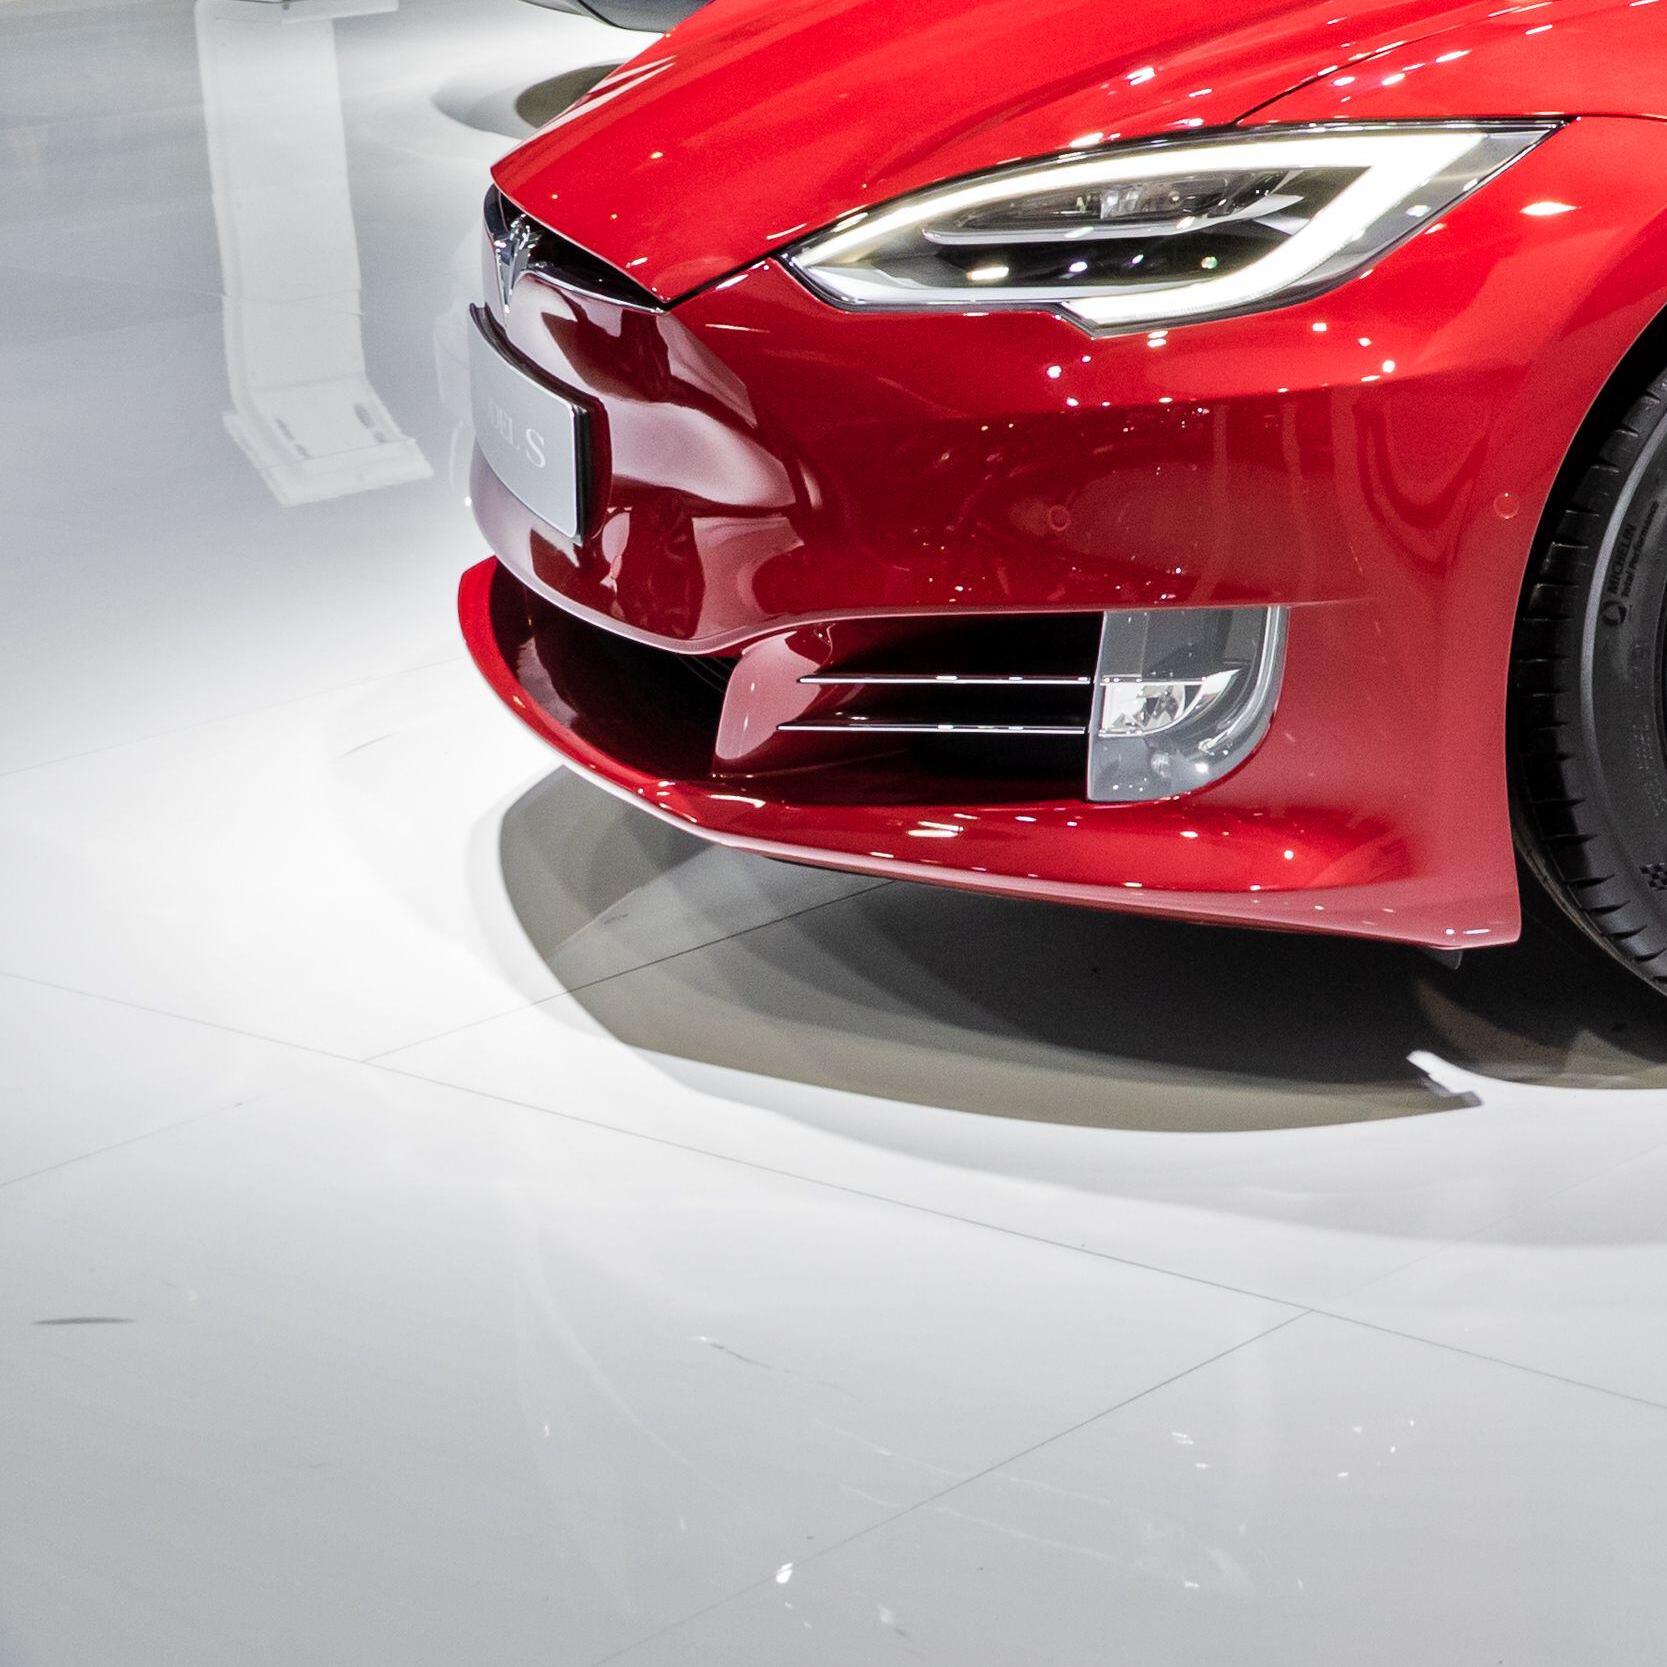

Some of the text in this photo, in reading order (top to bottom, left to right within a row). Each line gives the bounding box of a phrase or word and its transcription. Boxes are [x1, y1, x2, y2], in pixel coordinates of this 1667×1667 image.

[525, 428, 546, 468] S
[1606, 522, 1637, 594] MICHELIN
[1621, 500, 1660, 598] Total Performance
